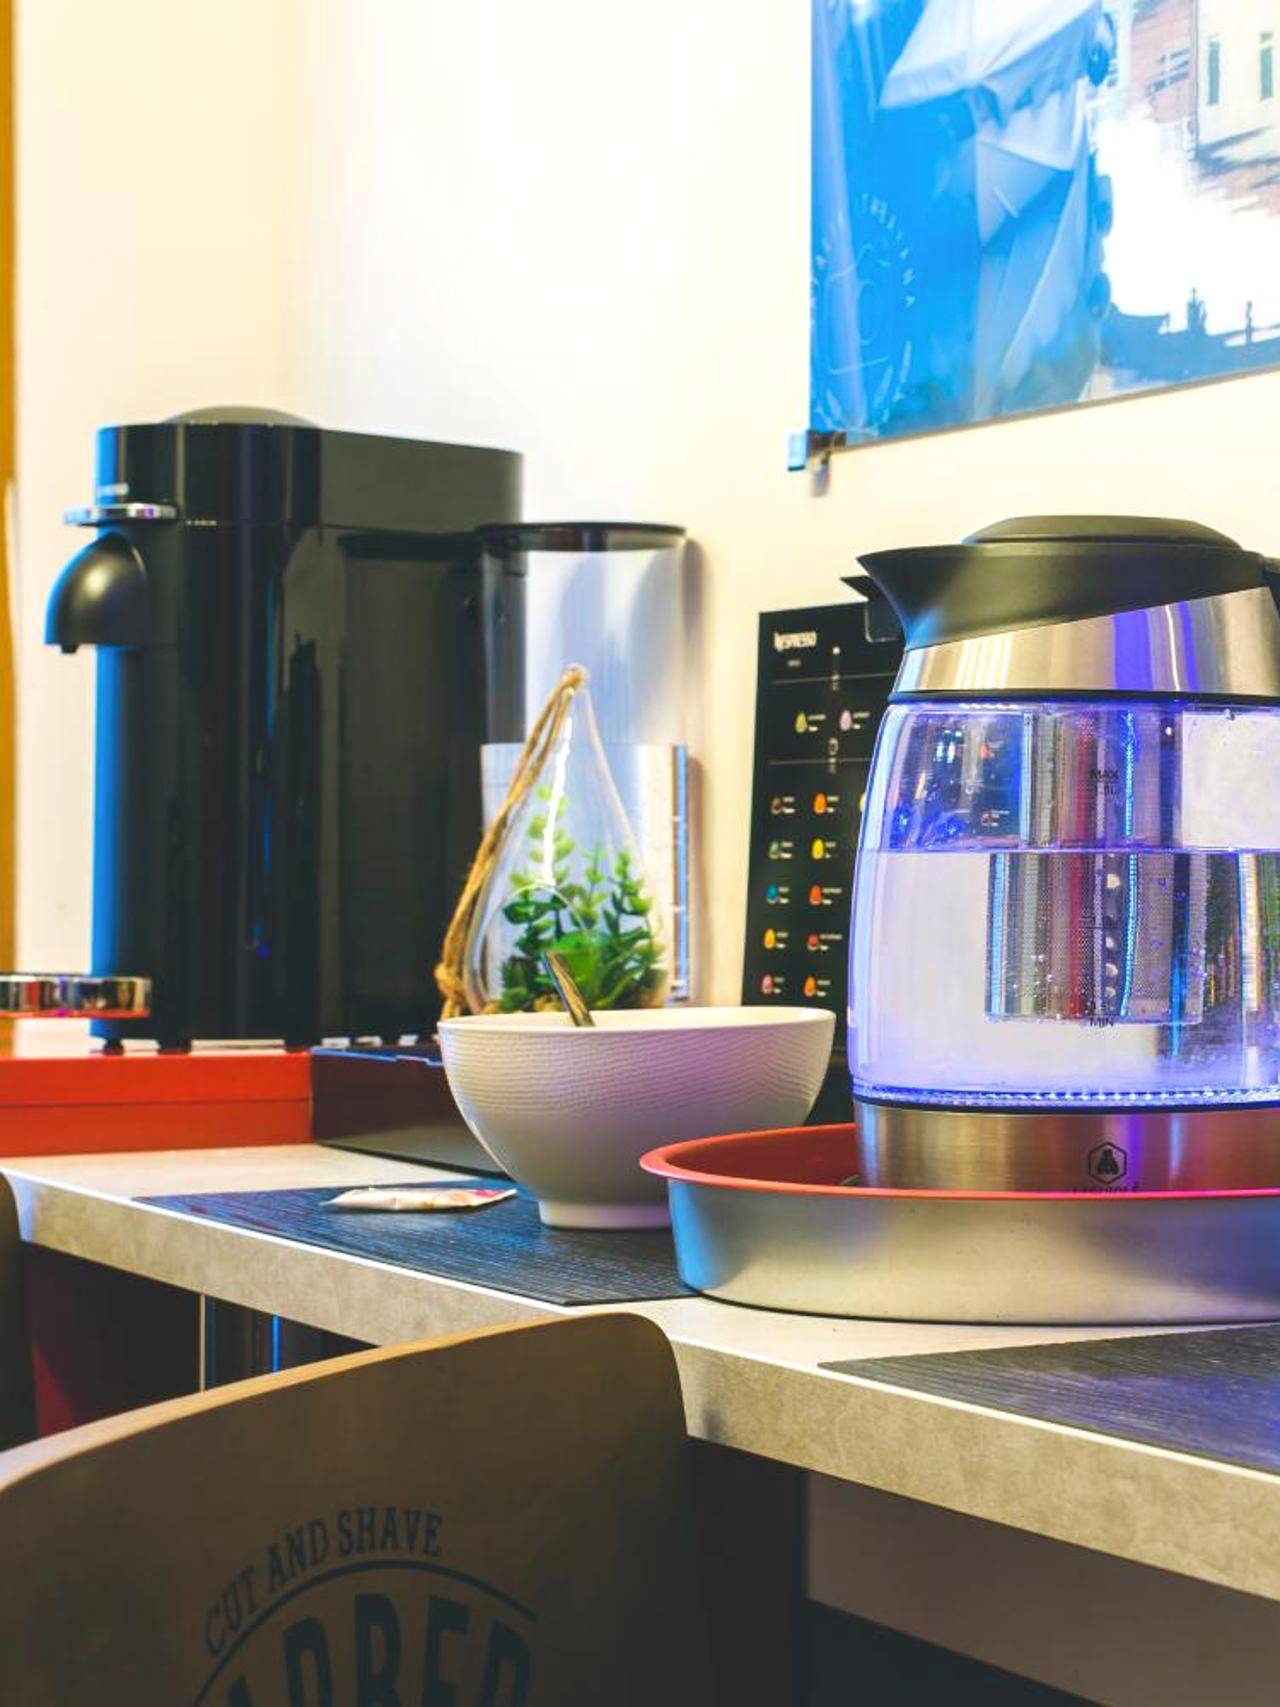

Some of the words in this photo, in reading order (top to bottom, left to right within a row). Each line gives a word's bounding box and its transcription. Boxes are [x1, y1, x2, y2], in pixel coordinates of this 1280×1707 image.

[204, 1564, 256, 1656] CUT
[266, 1518, 329, 1593] AND
[337, 1505, 443, 1559] SHAVE
